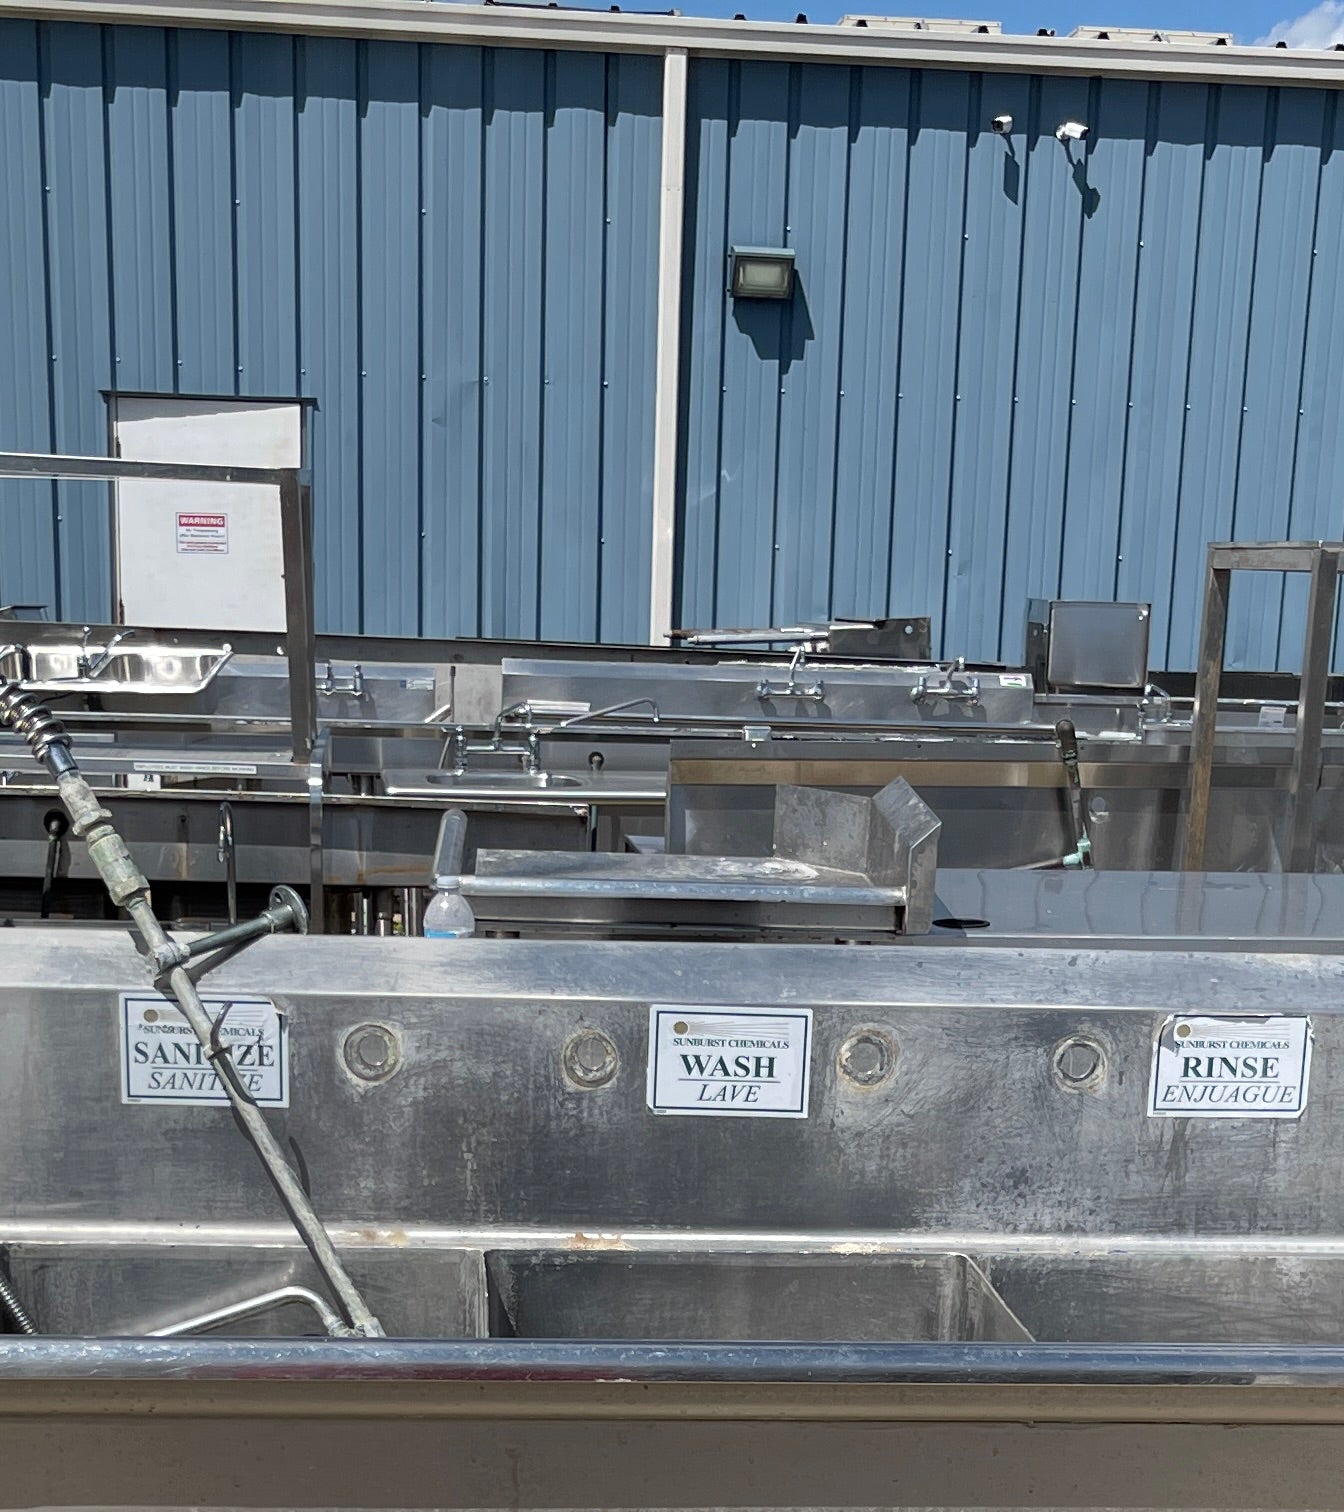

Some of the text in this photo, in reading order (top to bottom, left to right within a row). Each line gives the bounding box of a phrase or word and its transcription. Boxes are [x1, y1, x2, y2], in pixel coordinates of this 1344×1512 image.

[180, 517, 223, 525] WARNING
[672, 1038, 790, 1049] SUNBURST CHEMICALS
[1175, 1040, 1290, 1050] SUNBURST CHEMICALS
[134, 1042, 275, 1067] SANIZE
[679, 1054, 777, 1078] WASH
[1180, 1056, 1280, 1079] RINSE
[148, 1071, 263, 1092] SANITE
[697, 1083, 761, 1103] LAVE
[1161, 1085, 1297, 1104] ENJUAGUE
